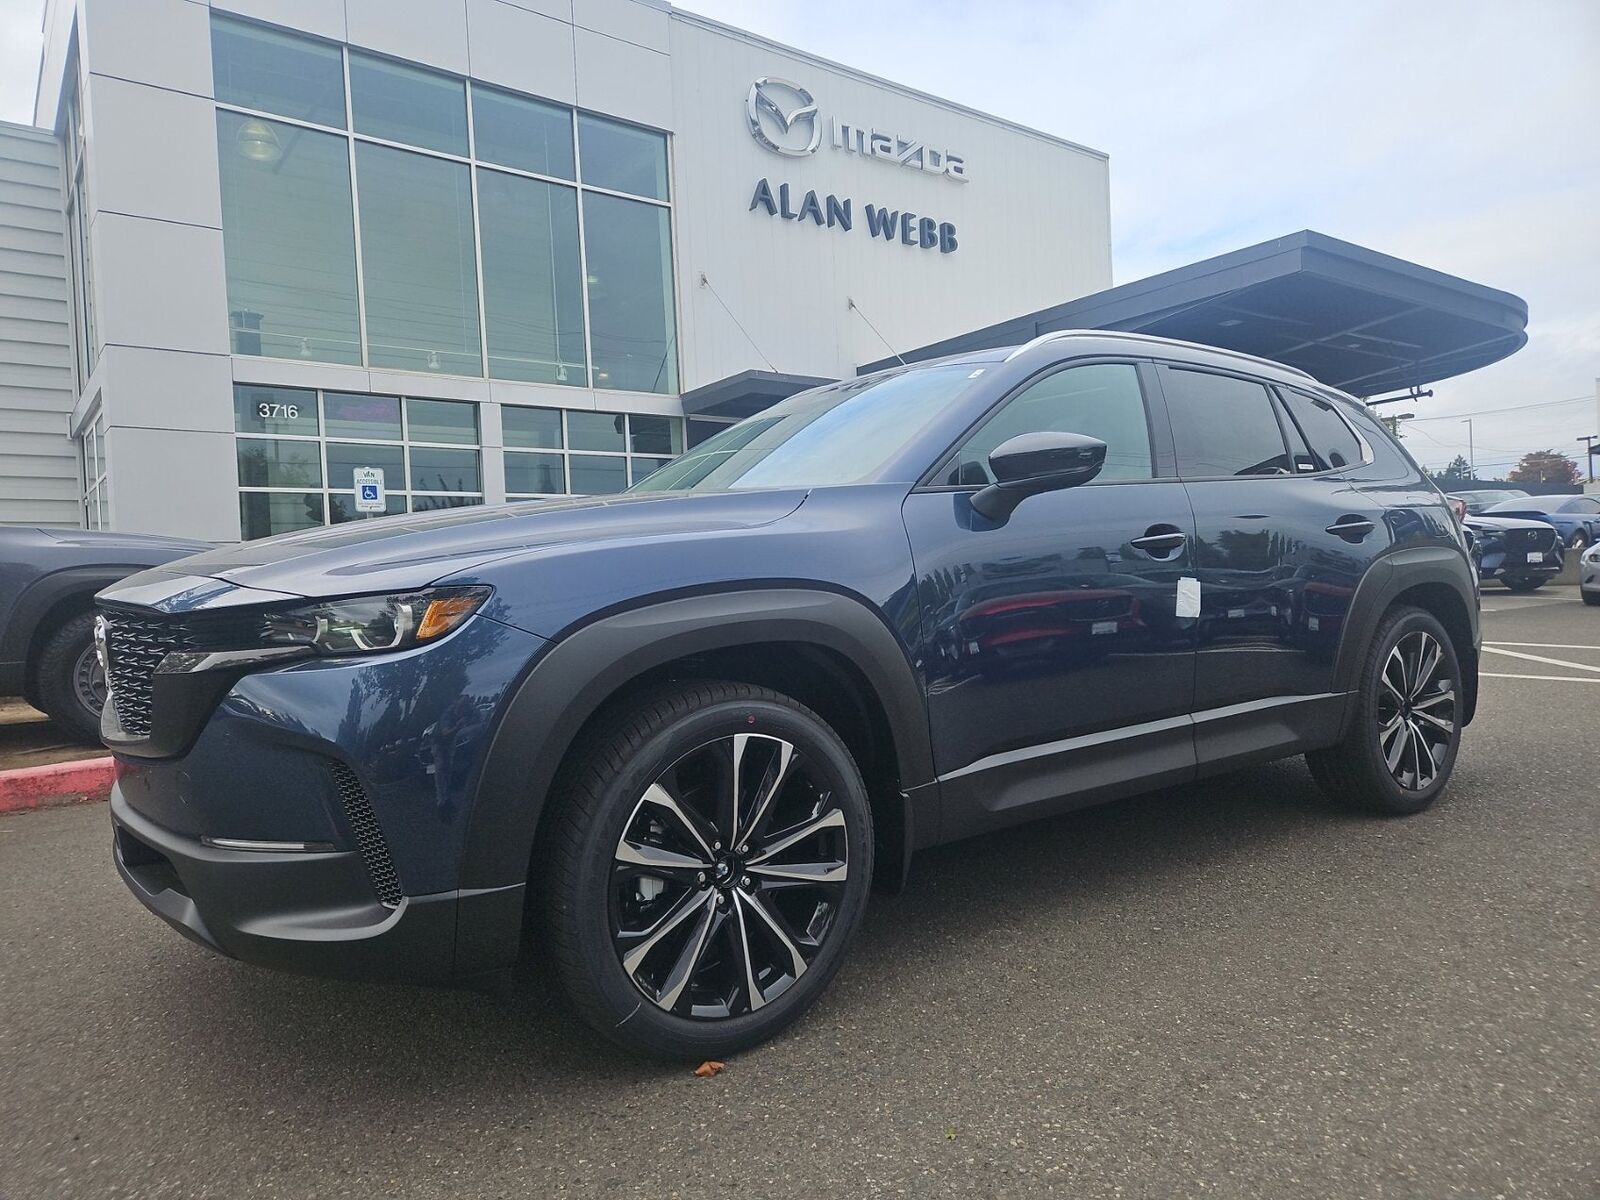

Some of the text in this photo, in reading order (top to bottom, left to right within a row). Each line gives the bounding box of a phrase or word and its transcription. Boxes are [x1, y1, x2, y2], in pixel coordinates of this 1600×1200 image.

[749, 176, 959, 254] ALAN WEBB
[259, 403, 299, 419] 3716
